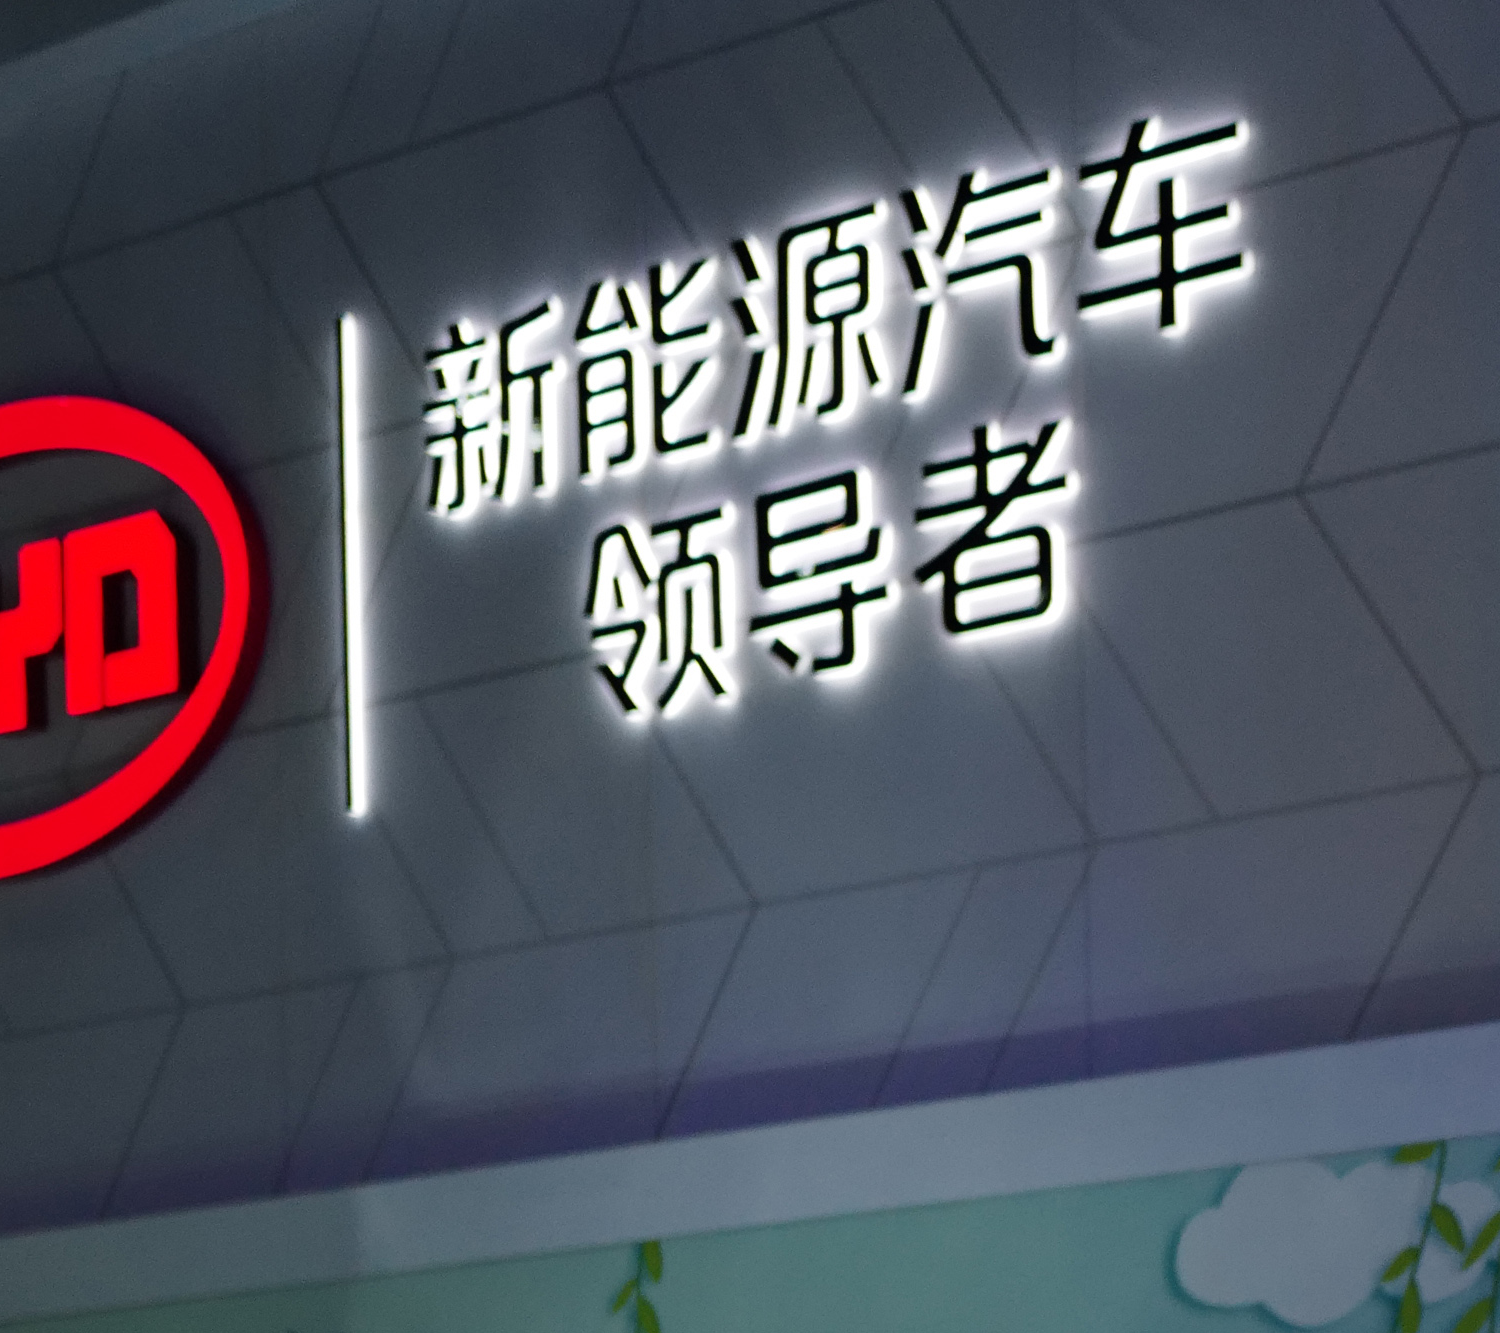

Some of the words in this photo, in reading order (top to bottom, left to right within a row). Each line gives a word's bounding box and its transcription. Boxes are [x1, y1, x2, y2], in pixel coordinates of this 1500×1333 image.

[421, 116, 1247, 515] 新能源汽车
[587, 420, 1073, 719] 领导者
